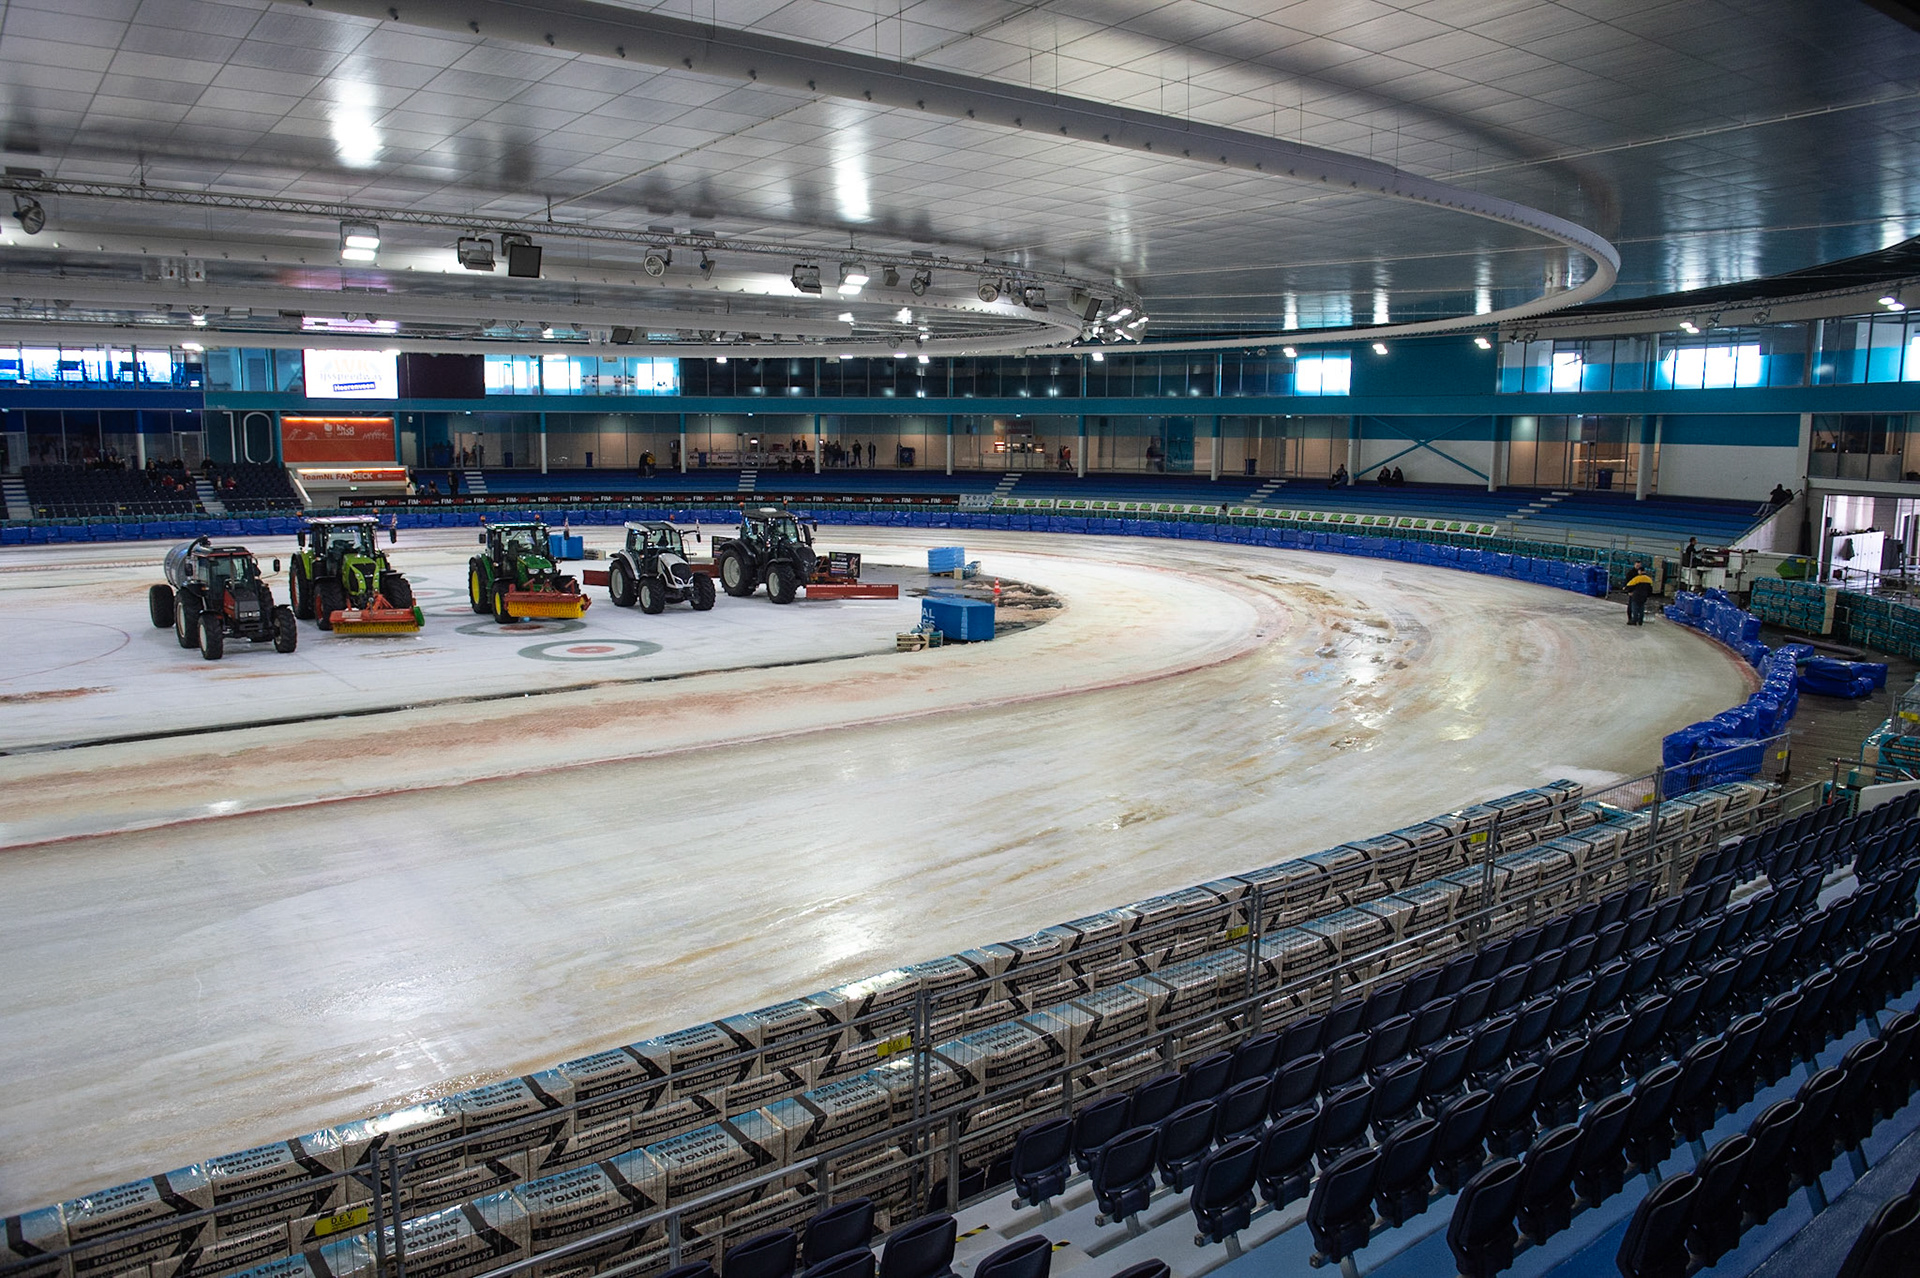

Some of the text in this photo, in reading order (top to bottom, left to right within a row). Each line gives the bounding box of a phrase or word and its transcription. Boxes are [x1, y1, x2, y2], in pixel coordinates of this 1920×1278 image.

[302, 473, 334, 481] TeamNL
[336, 472, 373, 481] FANDECK
[583, 1059, 625, 1074] VOLUME
[475, 1092, 523, 1107] VOLUME
[590, 1101, 621, 1115] EXTREME
[472, 1104, 529, 1122] WOODSHAVINGS
[398, 1118, 457, 1139] WOODSHAVINGS
[686, 1129, 713, 1140] Liter
[413, 1132, 451, 1149] EXTREME
[481, 1137, 517, 1151] EXTREME
[418, 1151, 452, 1168] VOLUME
[676, 1143, 727, 1164] VOLUME
[226, 1157, 281, 1175] VOLUME
[674, 1156, 735, 1181] WOODSHAVINGS
[220, 1168, 287, 1191] WOODSHAVINGS
[421, 1173, 480, 1194] WOODSHAVINGS
[526, 1174, 601, 1200] SPREADING
[683, 1161, 756, 1193] EXTREME VOLUME
[545, 1184, 601, 1205] VOLUME
[85, 1195, 146, 1216] VOLUME
[233, 1194, 315, 1222] EXTREME VOLUME
[540, 1200, 610, 1223] WOODSHAVINGS
[79, 1208, 152, 1234] WOODSHAVINGS
[550, 1220, 591, 1237] VOLUME
[214, 1230, 280, 1255] WOODSHAVINGS
[93, 1245, 140, 1266] EXTREME
[450, 1250, 494, 1270] EXTREME
[256, 1260, 293, 1275] Liter
